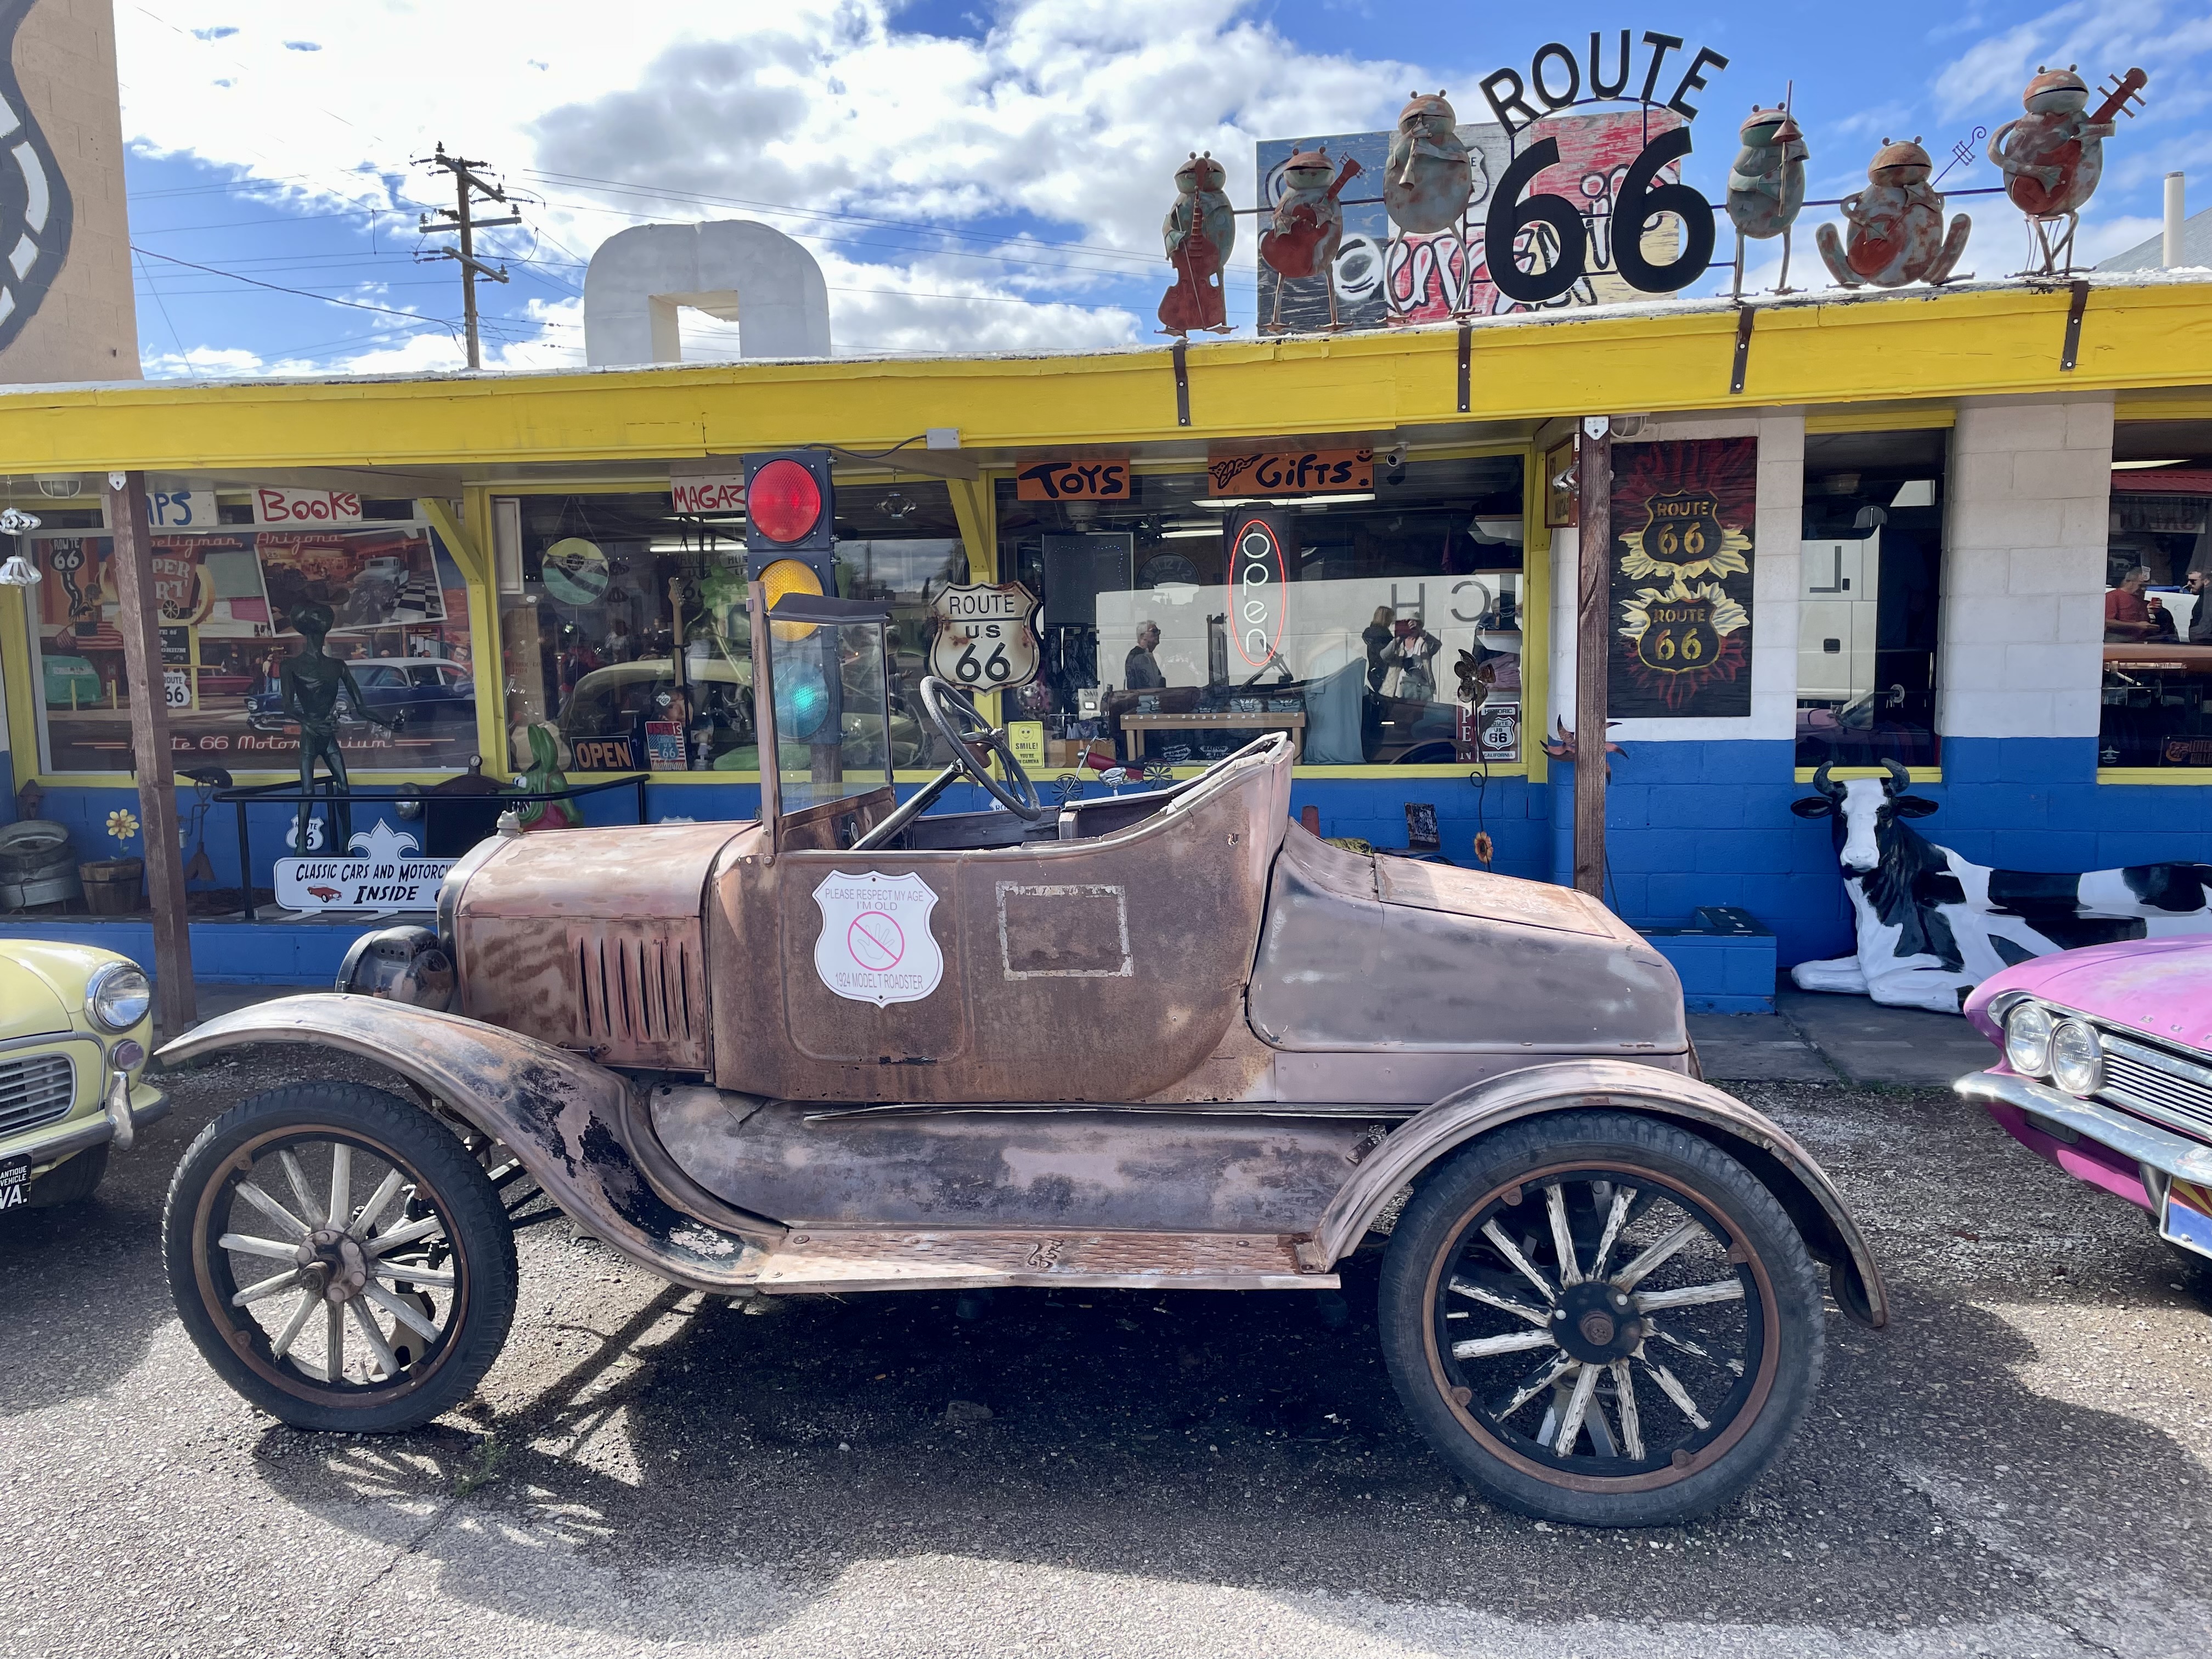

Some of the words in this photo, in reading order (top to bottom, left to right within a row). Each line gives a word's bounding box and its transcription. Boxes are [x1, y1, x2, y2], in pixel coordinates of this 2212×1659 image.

[1479, 29, 1730, 139] ROUTE
[1485, 126, 1716, 304] 66
[674, 485, 745, 513] MAGAZ
[1657, 501, 1709, 516] ROUTE
[257, 532, 345, 555] Arizona
[1658, 522, 1705, 554] 66
[55, 551, 80, 569] 66
[949, 594, 1015, 614] ROUTE
[1654, 608, 1706, 623] ROUTE
[1655, 628, 1701, 660] 66
[955, 642, 1010, 682] 66
[200, 736, 229, 750] 66
[1489, 732, 1508, 743] 66
[577, 742, 631, 768] OPEN
[663, 748, 676, 758] 66
[296, 864, 338, 882] CLASSIC
[341, 864, 370, 882] CARS
[373, 864, 394, 879] AND
[354, 885, 420, 905] INSIDE
[825, 888, 854, 900] PLEASE
[857, 889, 893, 901] RESPECT
[894, 890, 905, 901] MY
[907, 891, 924, 901] AGE
[857, 901, 871, 910] I'M
[874, 902, 898, 911] OLD
[836, 972, 850, 988] 1924
[852, 972, 877, 988] MODEL
[878, 973, 882, 989] T
[884, 974, 923, 990] ROADSTER
[0, 1165, 27, 1180] ANTIQUE
[0, 1173, 27, 1187] VEHICLE
